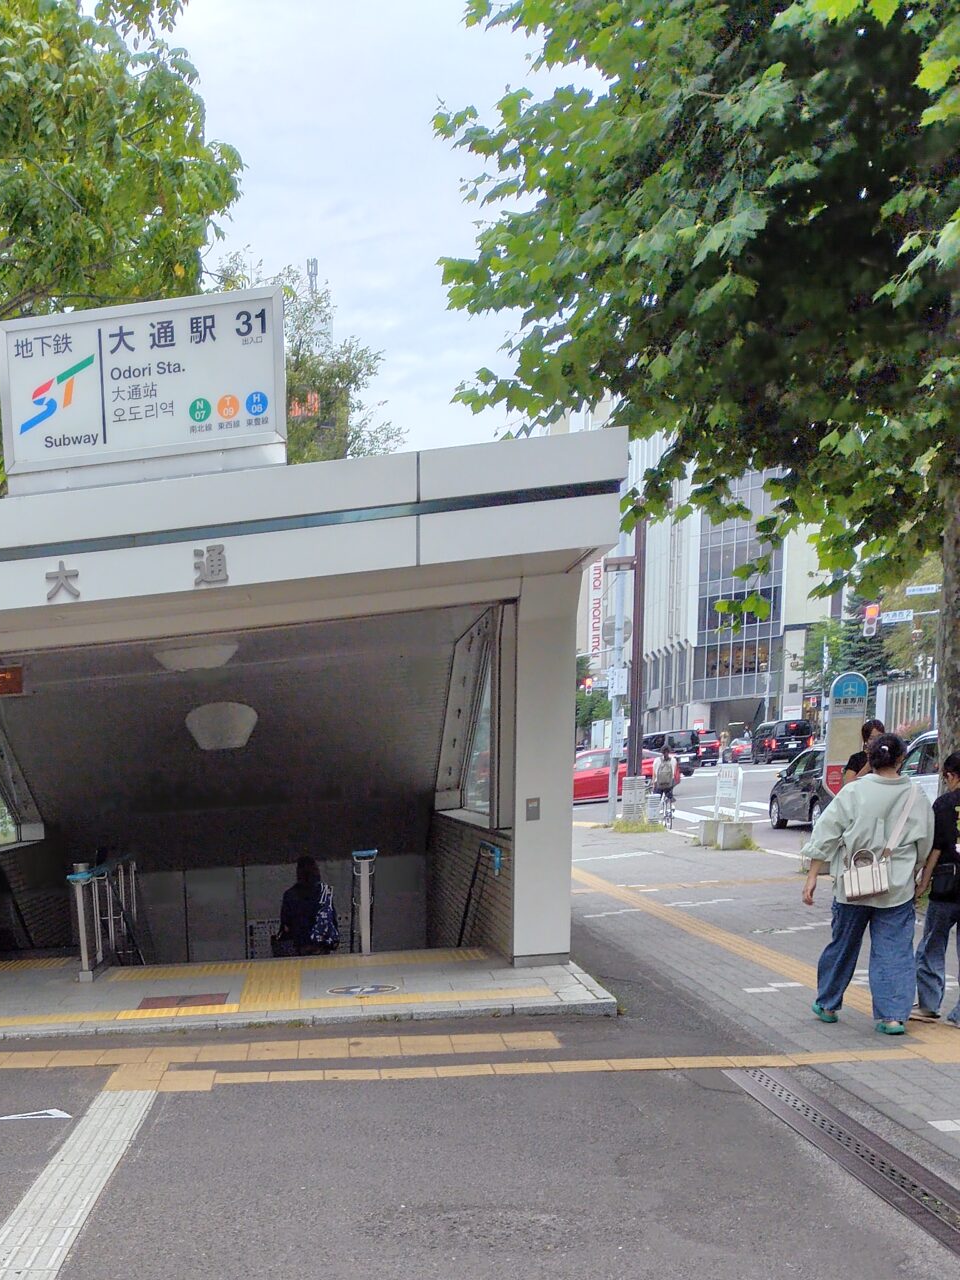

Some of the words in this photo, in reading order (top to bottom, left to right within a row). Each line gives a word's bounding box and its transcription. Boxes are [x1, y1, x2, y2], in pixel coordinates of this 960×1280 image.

[109, 314, 216, 355] 大通駅
[235, 308, 267, 337] 31
[241, 336, 263, 345] 出入口
[14, 332, 73, 358] 地下鉄
[110, 362, 152, 381] Odori
[156, 360, 186, 375] Sta.
[111, 381, 158, 403] 大通站
[253, 393, 261, 402] H
[112, 400, 174, 423] 오도리역
[194, 411, 206, 420] 07
[196, 401, 204, 409] N
[44, 433, 99, 449] Subway
[45, 543, 229, 601] 大通
